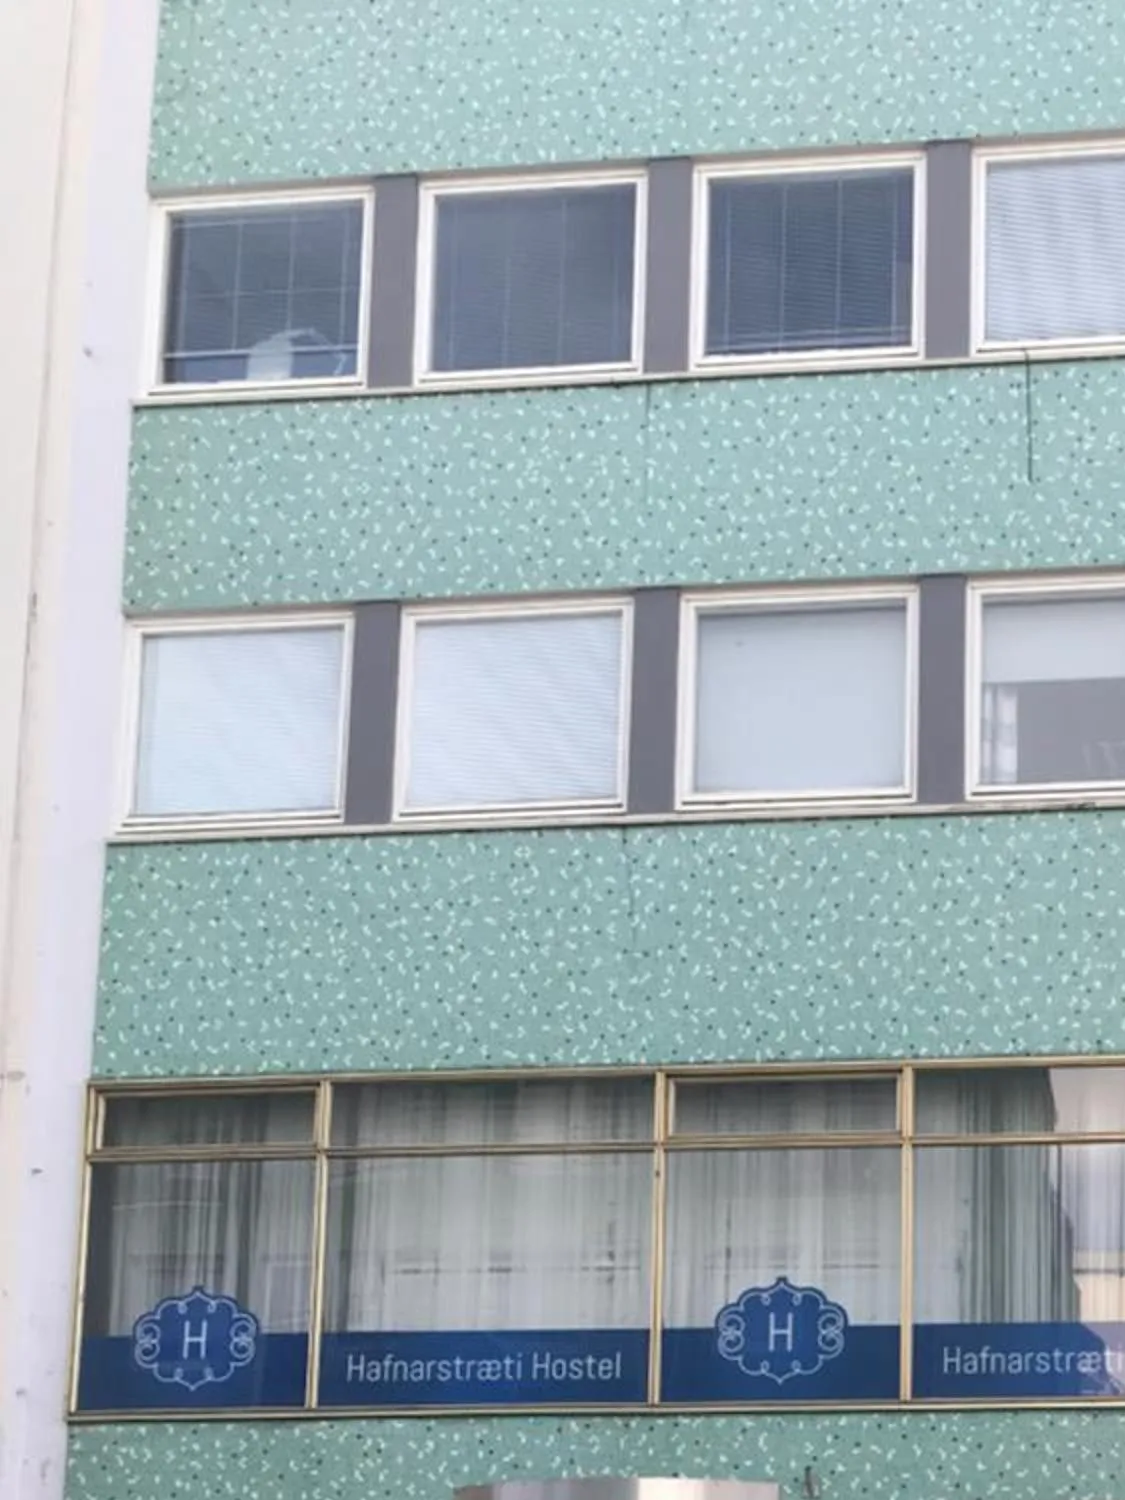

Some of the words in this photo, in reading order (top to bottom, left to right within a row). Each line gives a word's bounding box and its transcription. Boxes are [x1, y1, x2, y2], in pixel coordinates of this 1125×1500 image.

[182, 1319, 207, 1360] H
[768, 1311, 793, 1353] H
[346, 1351, 524, 1383] Hafnarstræti
[530, 1351, 623, 1381] Hostel
[942, 1343, 1125, 1375] Hafnarstræti
